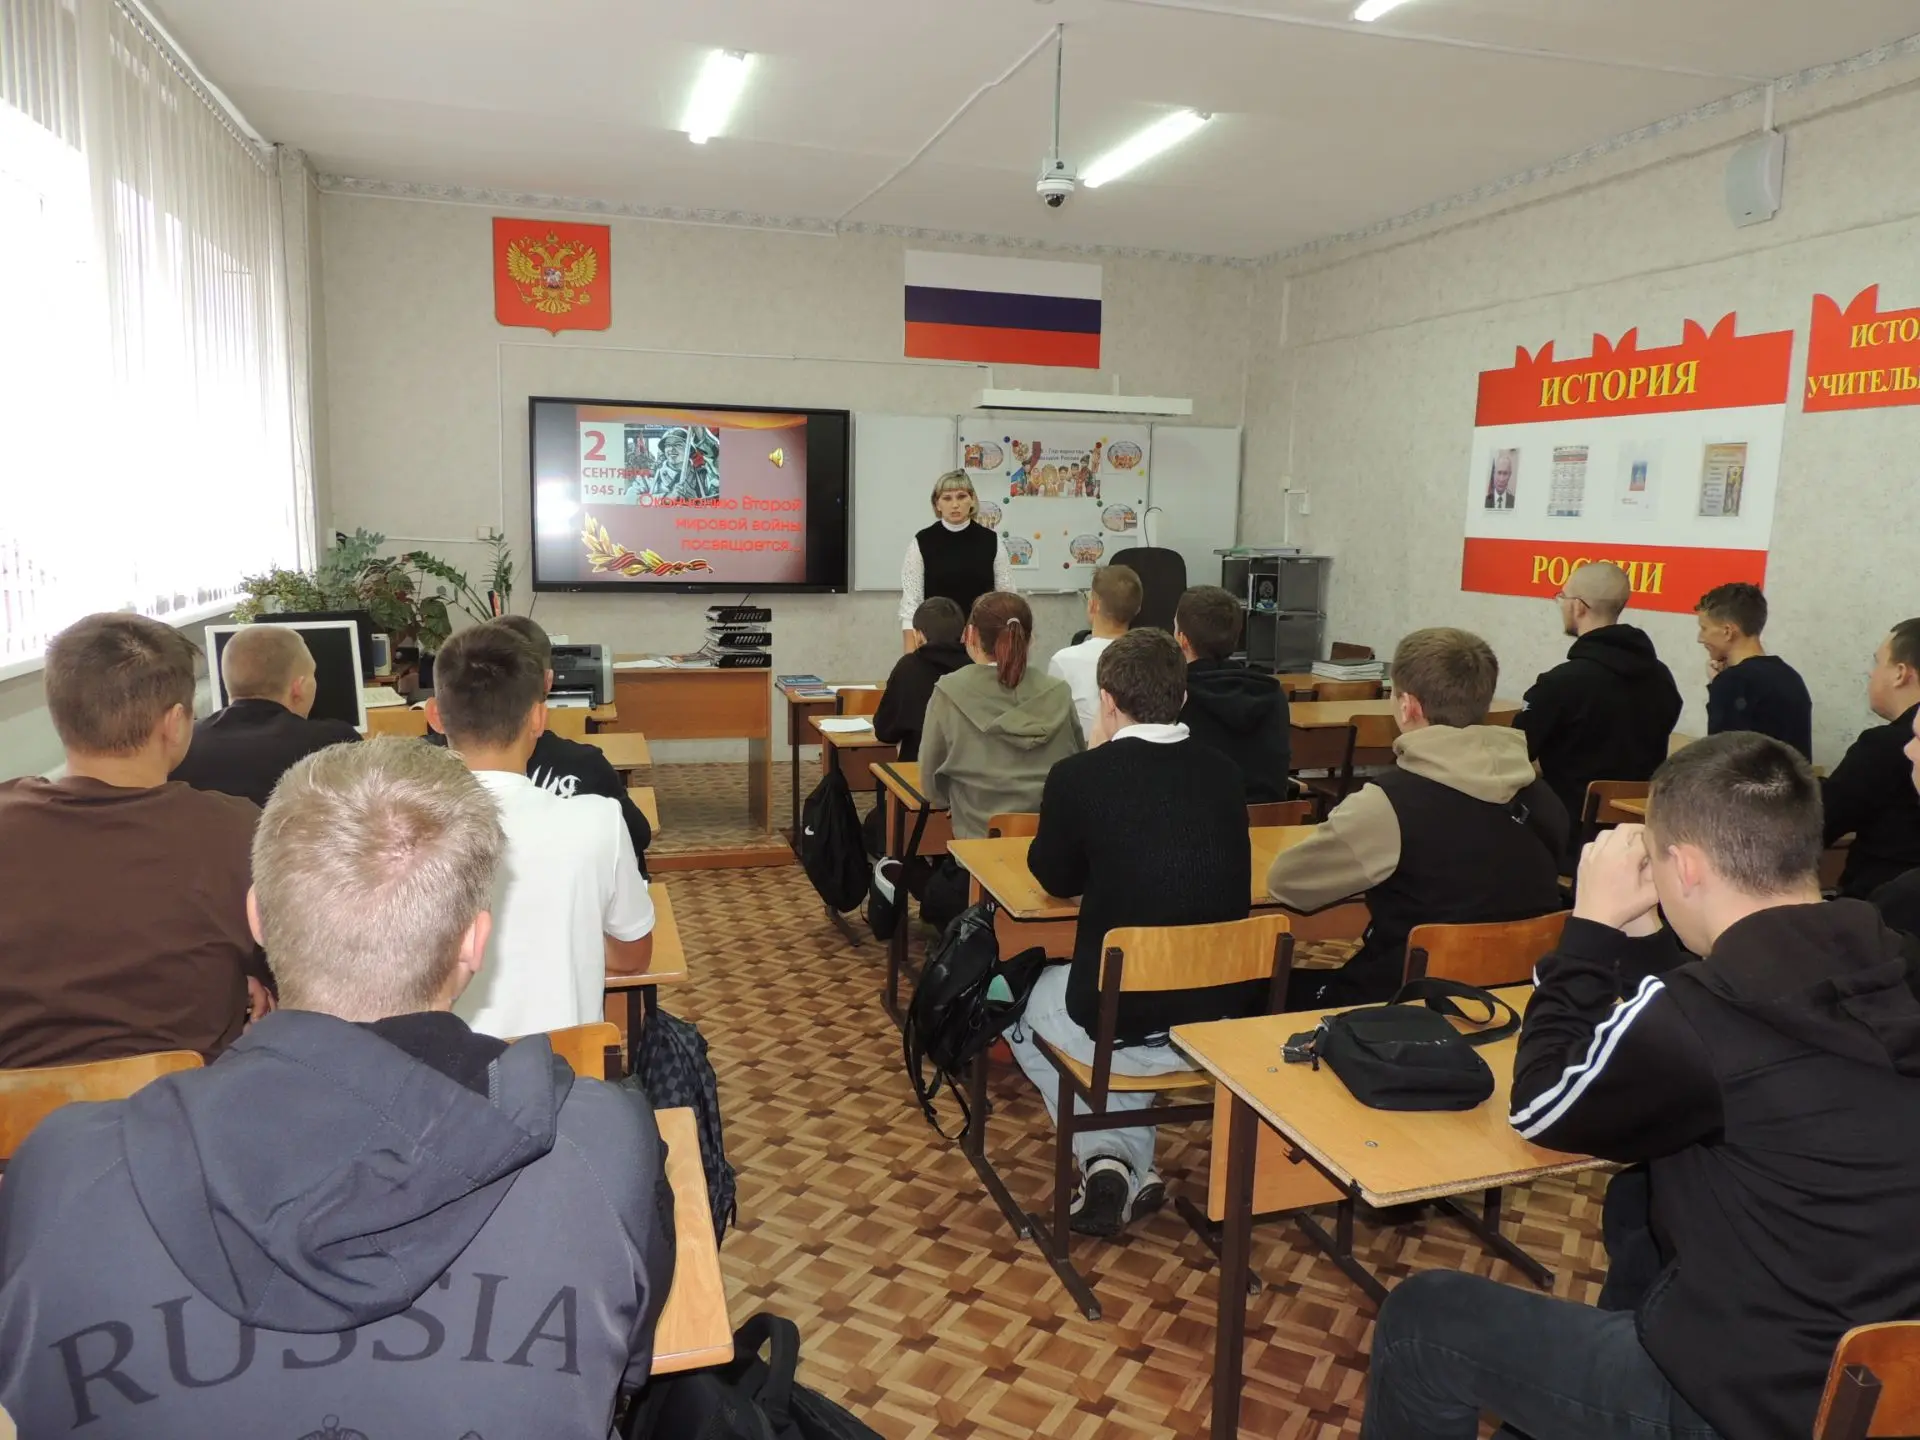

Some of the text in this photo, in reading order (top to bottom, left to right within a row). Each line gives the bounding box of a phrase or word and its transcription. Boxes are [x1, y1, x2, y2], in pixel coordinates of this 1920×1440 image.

[1850, 317, 1920, 349] ИСТО
[1539, 360, 1700, 408] ИСТОРИЯ
[1808, 366, 1920, 398] УЧИТЕЛЬ
[584, 430, 606, 461] 2
[584, 485, 616, 496] 1945
[675, 517, 803, 532] мировой войны
[1531, 555, 1666, 594] РОИИ
